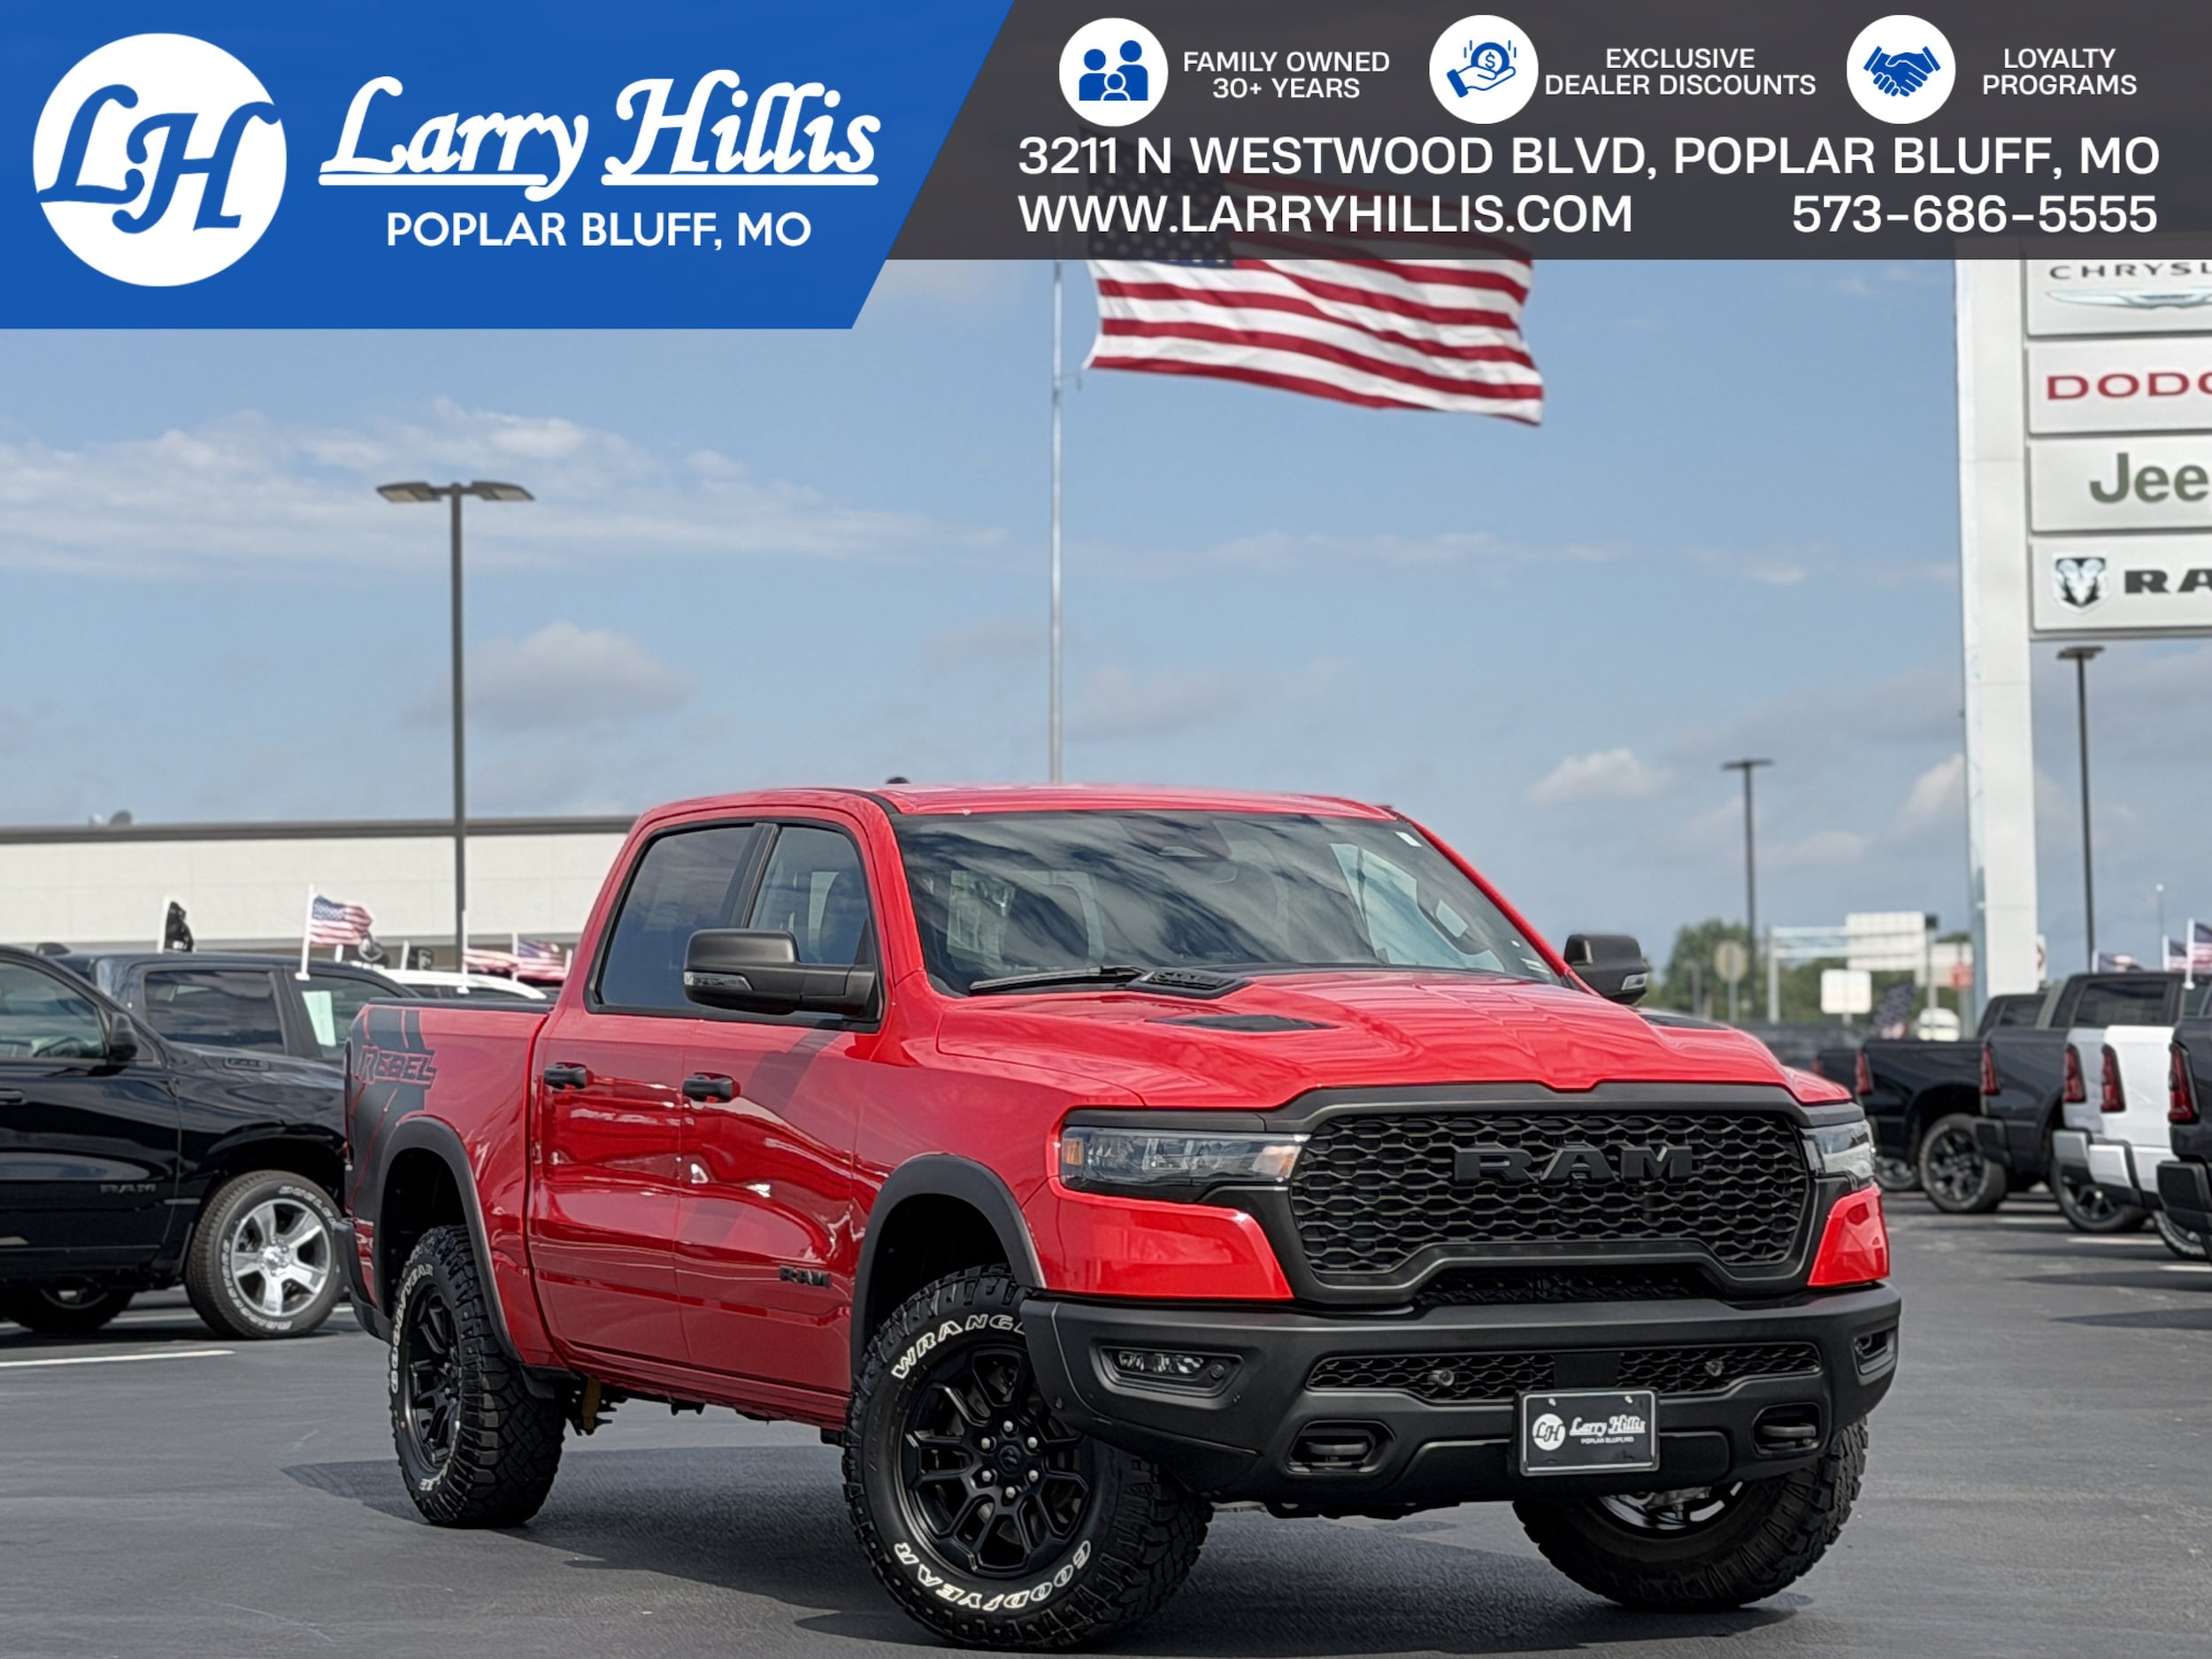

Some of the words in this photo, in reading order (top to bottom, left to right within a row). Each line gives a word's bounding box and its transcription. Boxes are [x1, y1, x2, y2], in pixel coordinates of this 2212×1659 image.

[2089, 452, 2209, 504] Jee
[357, 1046, 437, 1088] REBEL
[1454, 1146, 1693, 1183] RAM
[1569, 1417, 1607, 1437] Larry
[1608, 1414, 1646, 1434] Hillis
[895, 1540, 1092, 1612] GOODYEAR
